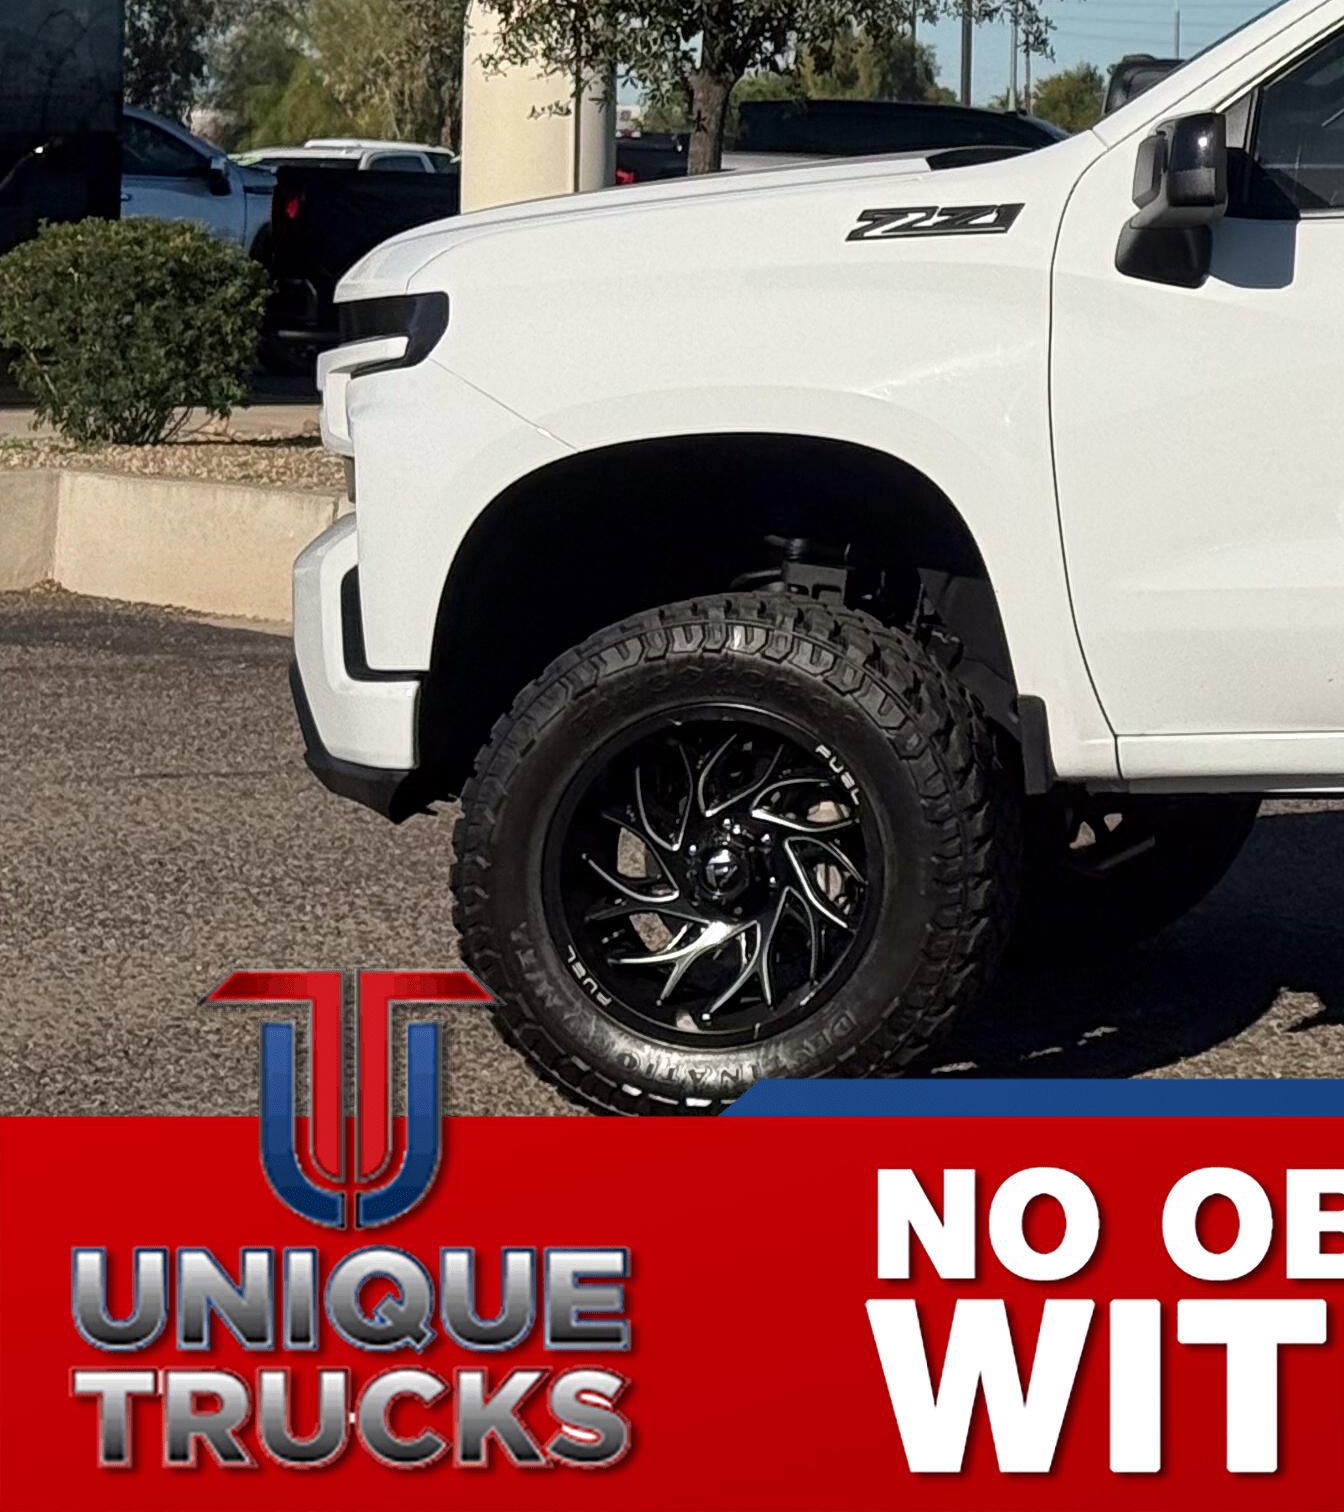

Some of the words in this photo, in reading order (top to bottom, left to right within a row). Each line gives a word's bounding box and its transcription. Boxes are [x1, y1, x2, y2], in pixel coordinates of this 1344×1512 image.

[845, 202, 1026, 242] Z71
[815, 744, 860, 806] FUEL
[566, 944, 612, 1007] FUEL
